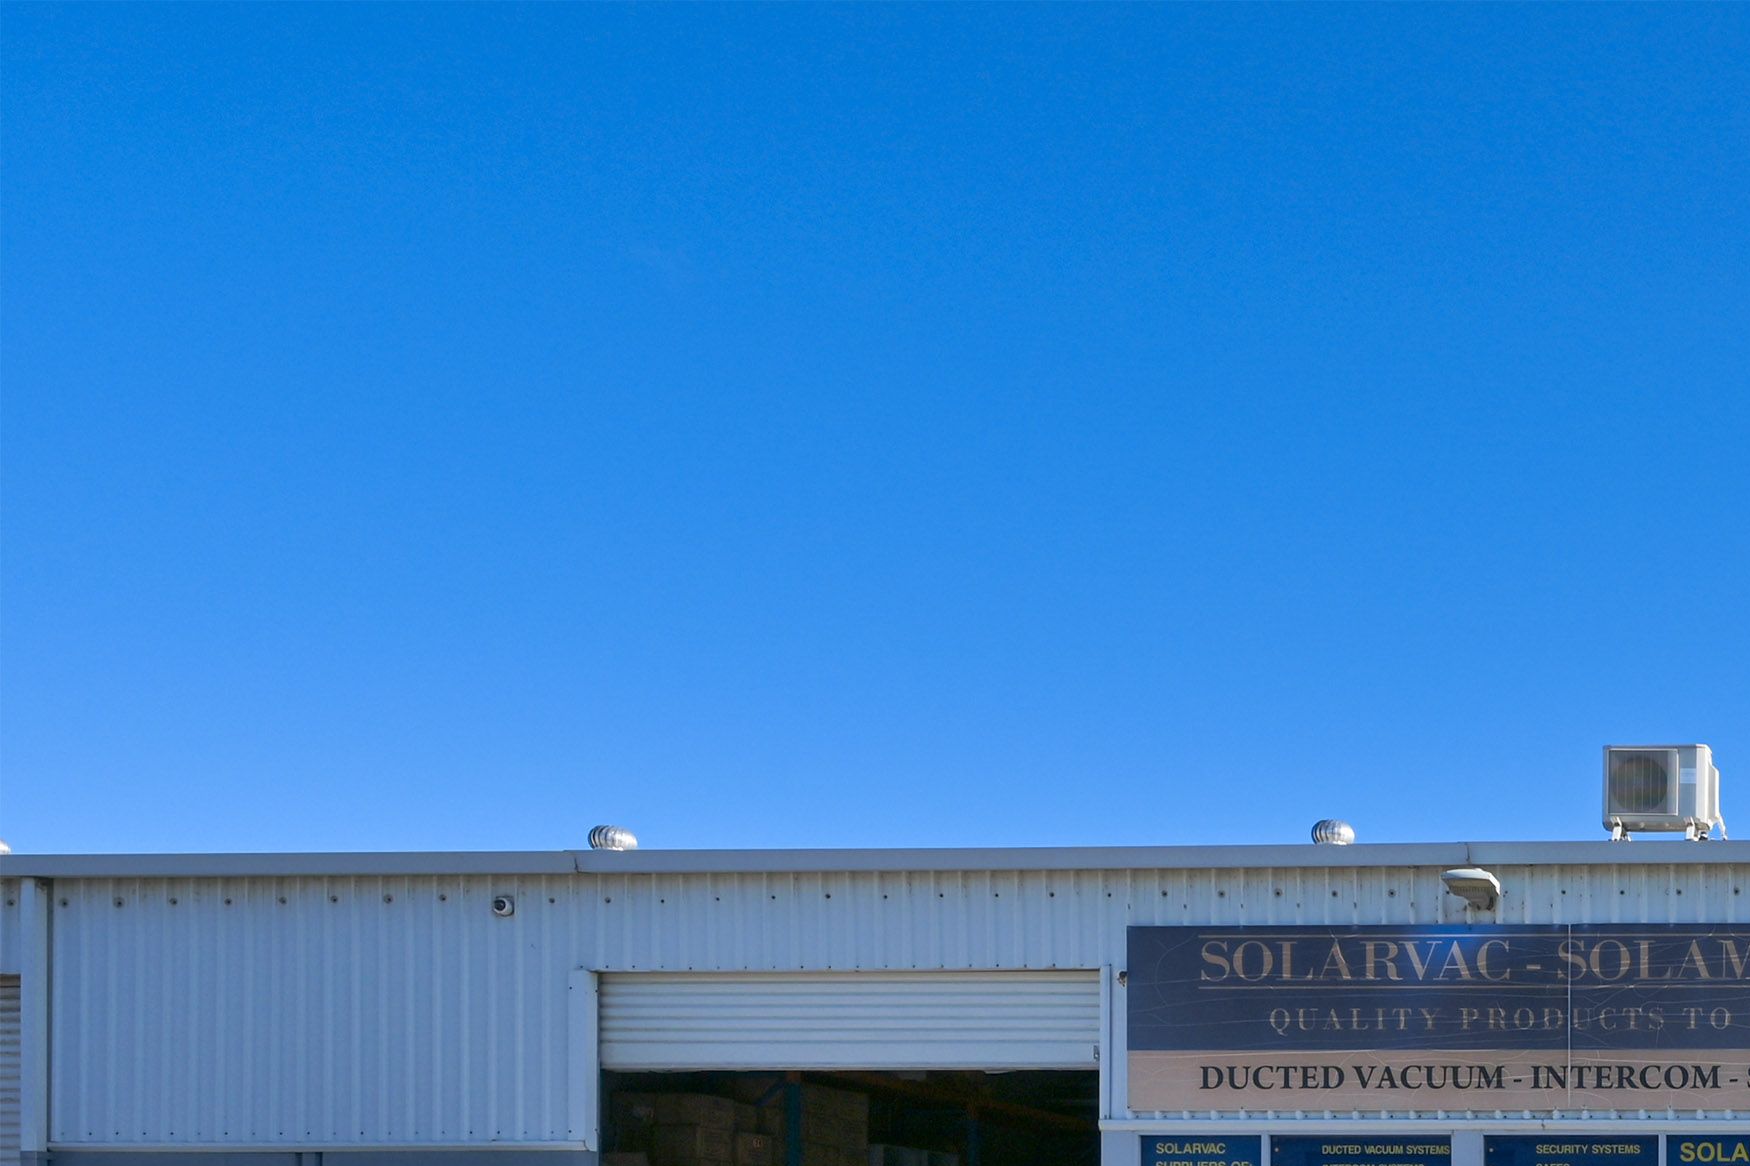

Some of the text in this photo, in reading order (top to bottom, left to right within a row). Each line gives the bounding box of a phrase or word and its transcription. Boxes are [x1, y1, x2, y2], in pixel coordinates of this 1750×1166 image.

[1201, 939, 1510, 981] SOLARVAC
[1269, 1007, 1438, 1036] QUALITY
[1459, 1007, 1664, 1031] PRODUCTS
[1682, 1007, 1731, 1030] TO
[1200, 1065, 1345, 1090] DUCTED
[1352, 1065, 1505, 1090] VACUUM
[1530, 1064, 1722, 1089] INTERCOM
[1156, 1143, 1226, 1154] SOLARVAC
[1322, 1145, 1450, 1155] DUCTED VACUUM SYSTEMS
[1536, 1144, 1641, 1154] SECURITY SYSTEMS
